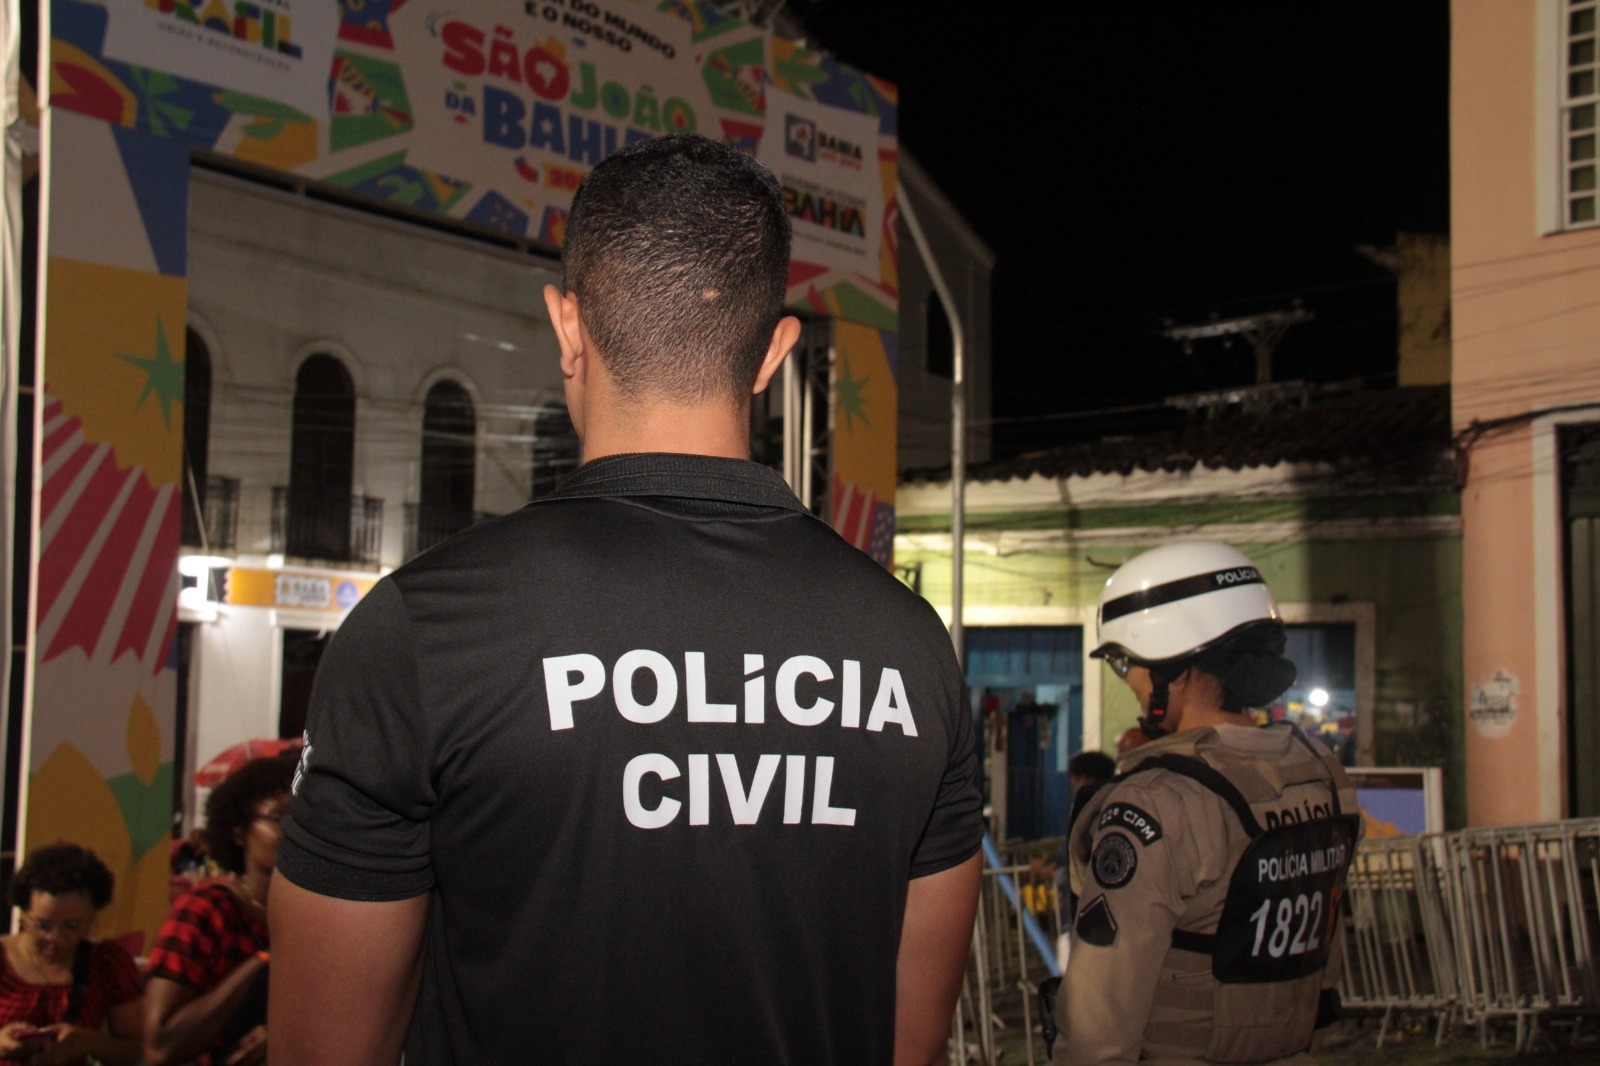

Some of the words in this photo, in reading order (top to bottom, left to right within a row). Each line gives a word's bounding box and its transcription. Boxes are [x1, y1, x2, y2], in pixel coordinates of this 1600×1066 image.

[543, 6, 557, 21] O
[563, 12, 632, 52] NOSSO
[605, 11, 675, 59] MUNDO
[441, 20, 569, 102] SÃO
[445, 91, 475, 116] DA
[570, 61, 696, 136] JOÃO
[1215, 568, 1258, 586] POLÍCIA
[543, 649, 918, 737] POLÍCIA
[622, 753, 857, 830] CIVIL
[1122, 809, 1156, 841] CIPM
[1258, 851, 1309, 883] POLÍCIA
[1310, 844, 1346, 875] MILITAR
[1250, 890, 1323, 958] 1822
